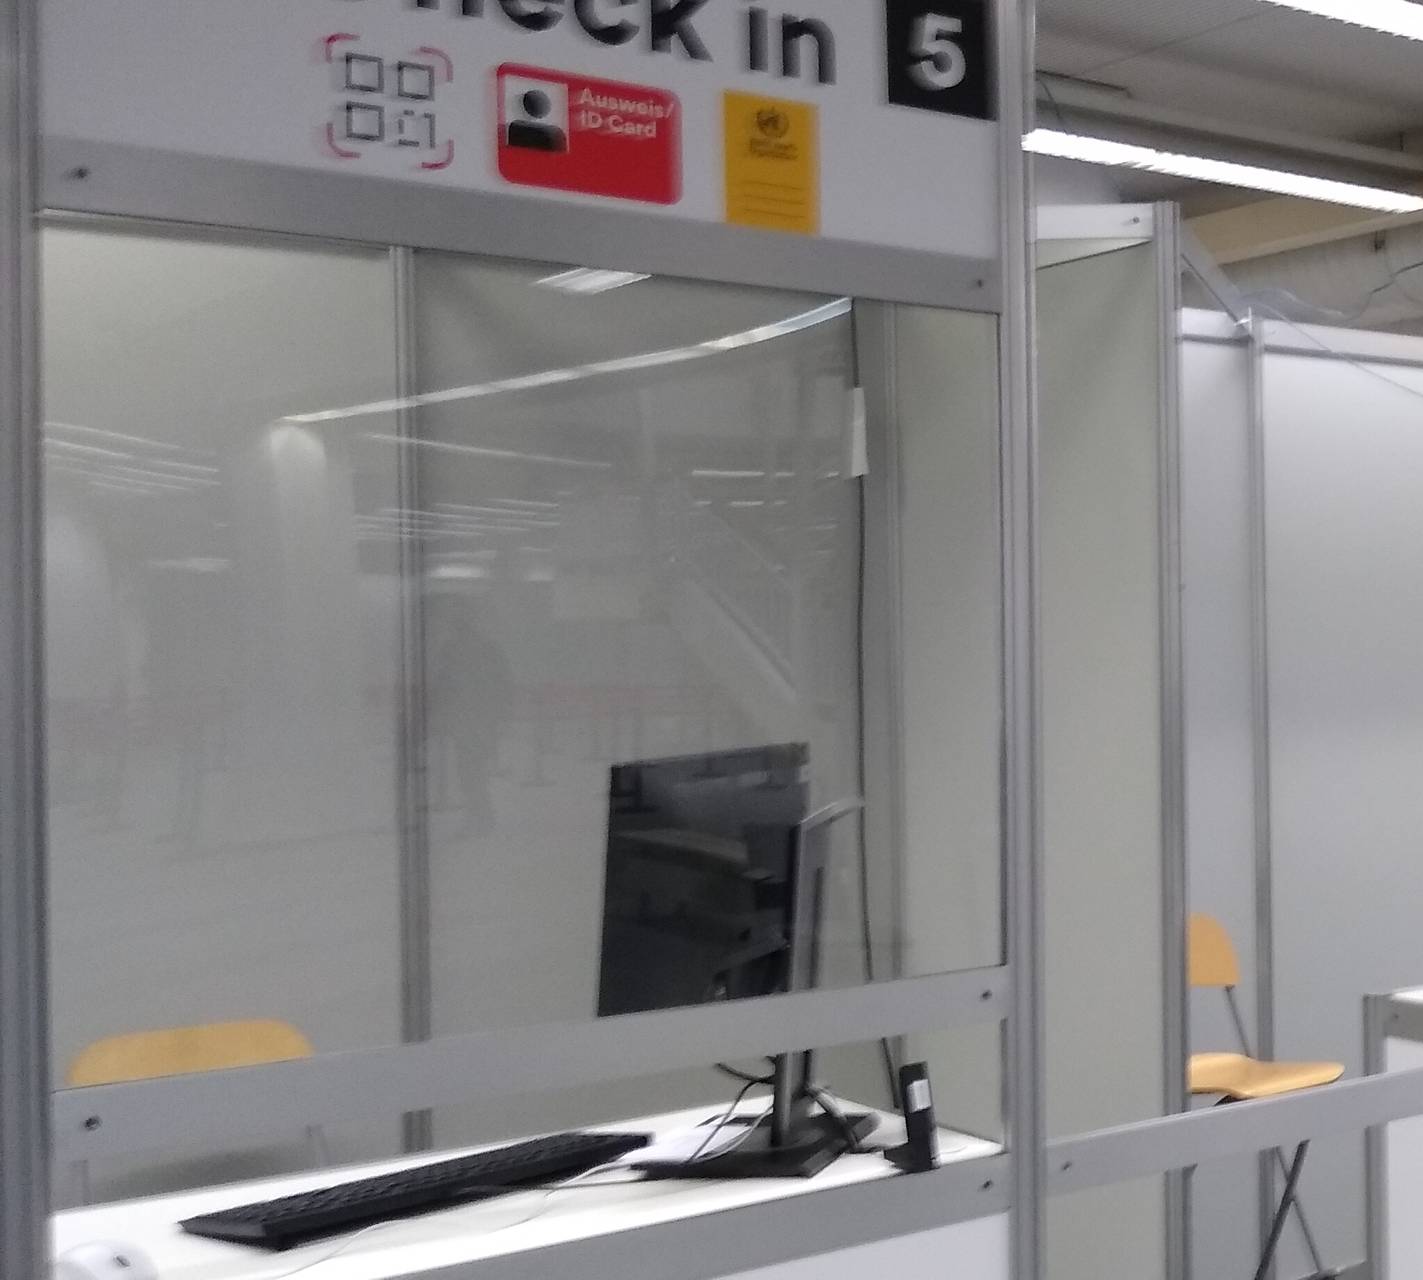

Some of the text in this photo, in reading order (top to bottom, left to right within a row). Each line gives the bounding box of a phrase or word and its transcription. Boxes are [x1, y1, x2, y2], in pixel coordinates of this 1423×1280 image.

[908, 11, 967, 91] 5
[580, 109, 657, 138] ID Card
